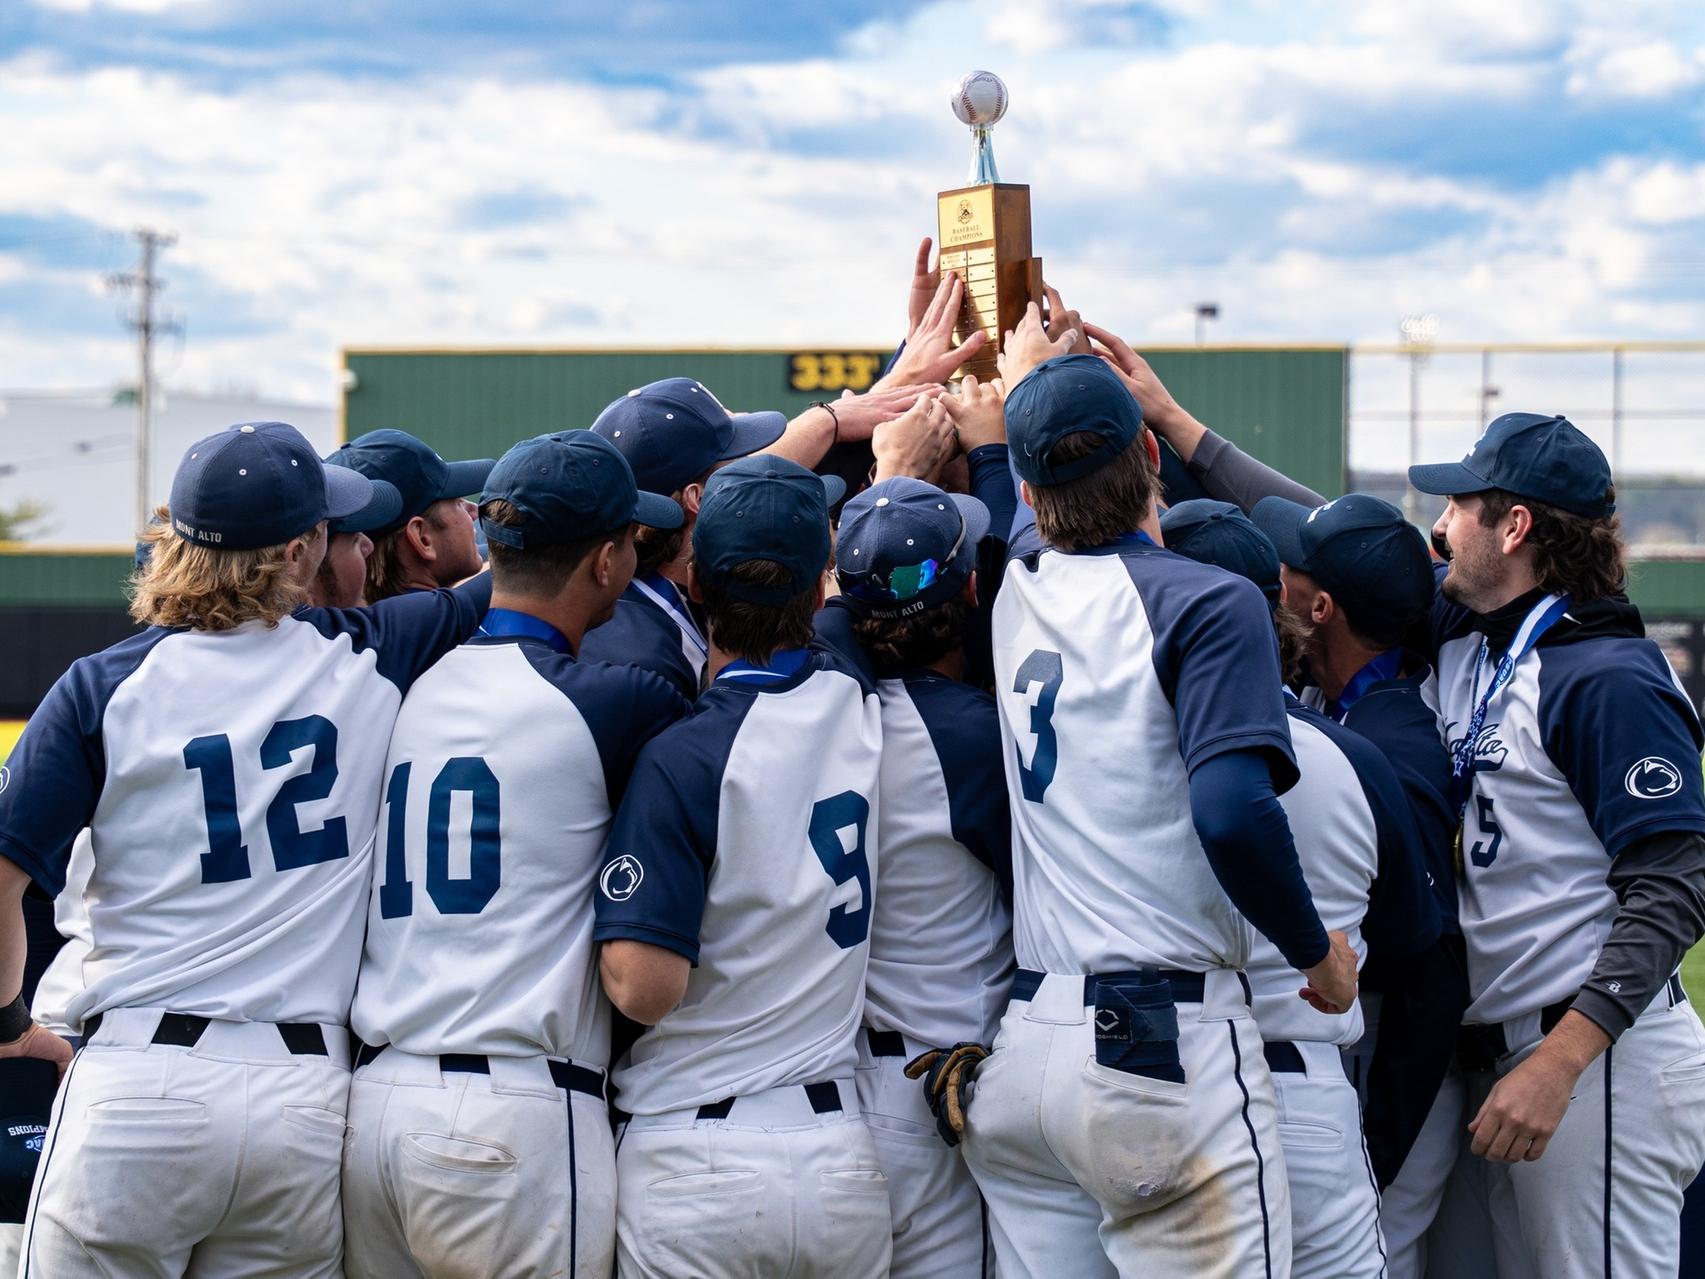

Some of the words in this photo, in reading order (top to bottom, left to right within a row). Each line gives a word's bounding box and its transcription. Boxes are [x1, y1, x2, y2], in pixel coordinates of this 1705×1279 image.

[950, 232, 983, 242] CHAMPIONS
[952, 225, 981, 234] BASEBALL
[198, 530, 222, 543] ALTO
[901, 601, 925, 616] ALTO
[1013, 649, 1064, 804] 3
[182, 714, 349, 884] 12
[1470, 795, 1502, 868] 5
[380, 757, 501, 920] 10
[808, 790, 872, 949] 9
